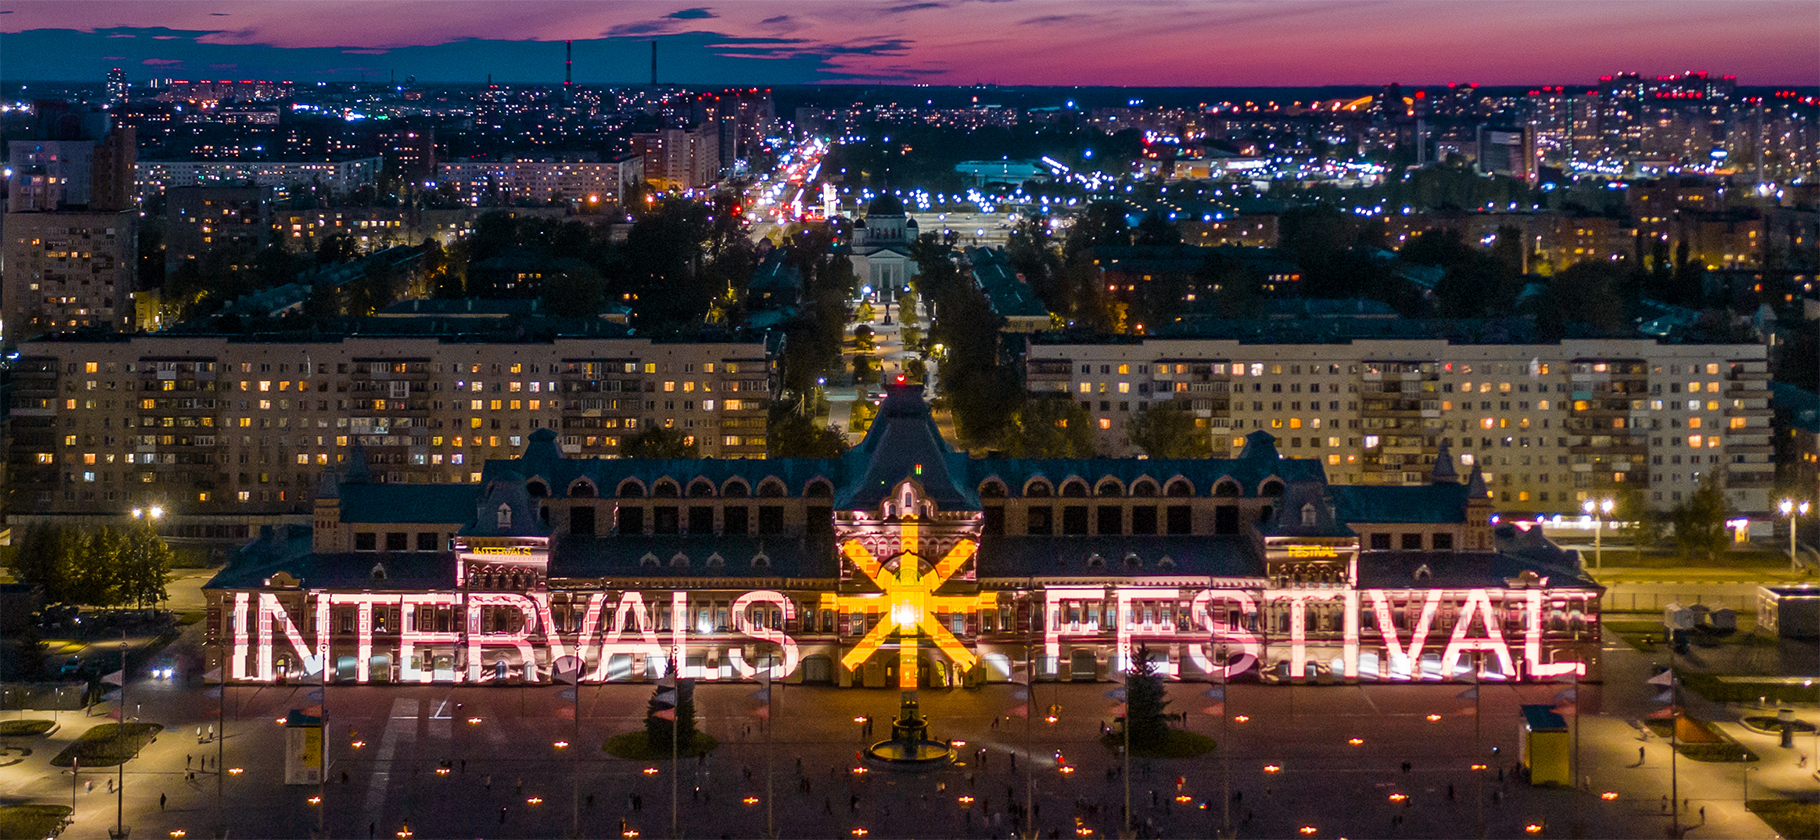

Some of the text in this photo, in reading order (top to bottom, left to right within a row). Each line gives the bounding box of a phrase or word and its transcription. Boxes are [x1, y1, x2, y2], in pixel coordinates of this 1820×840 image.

[473, 547, 531, 557] INTERVALS
[1288, 547, 1338, 557] FESTIVAL
[231, 589, 1586, 681] INTERVALS FESTIVAL
